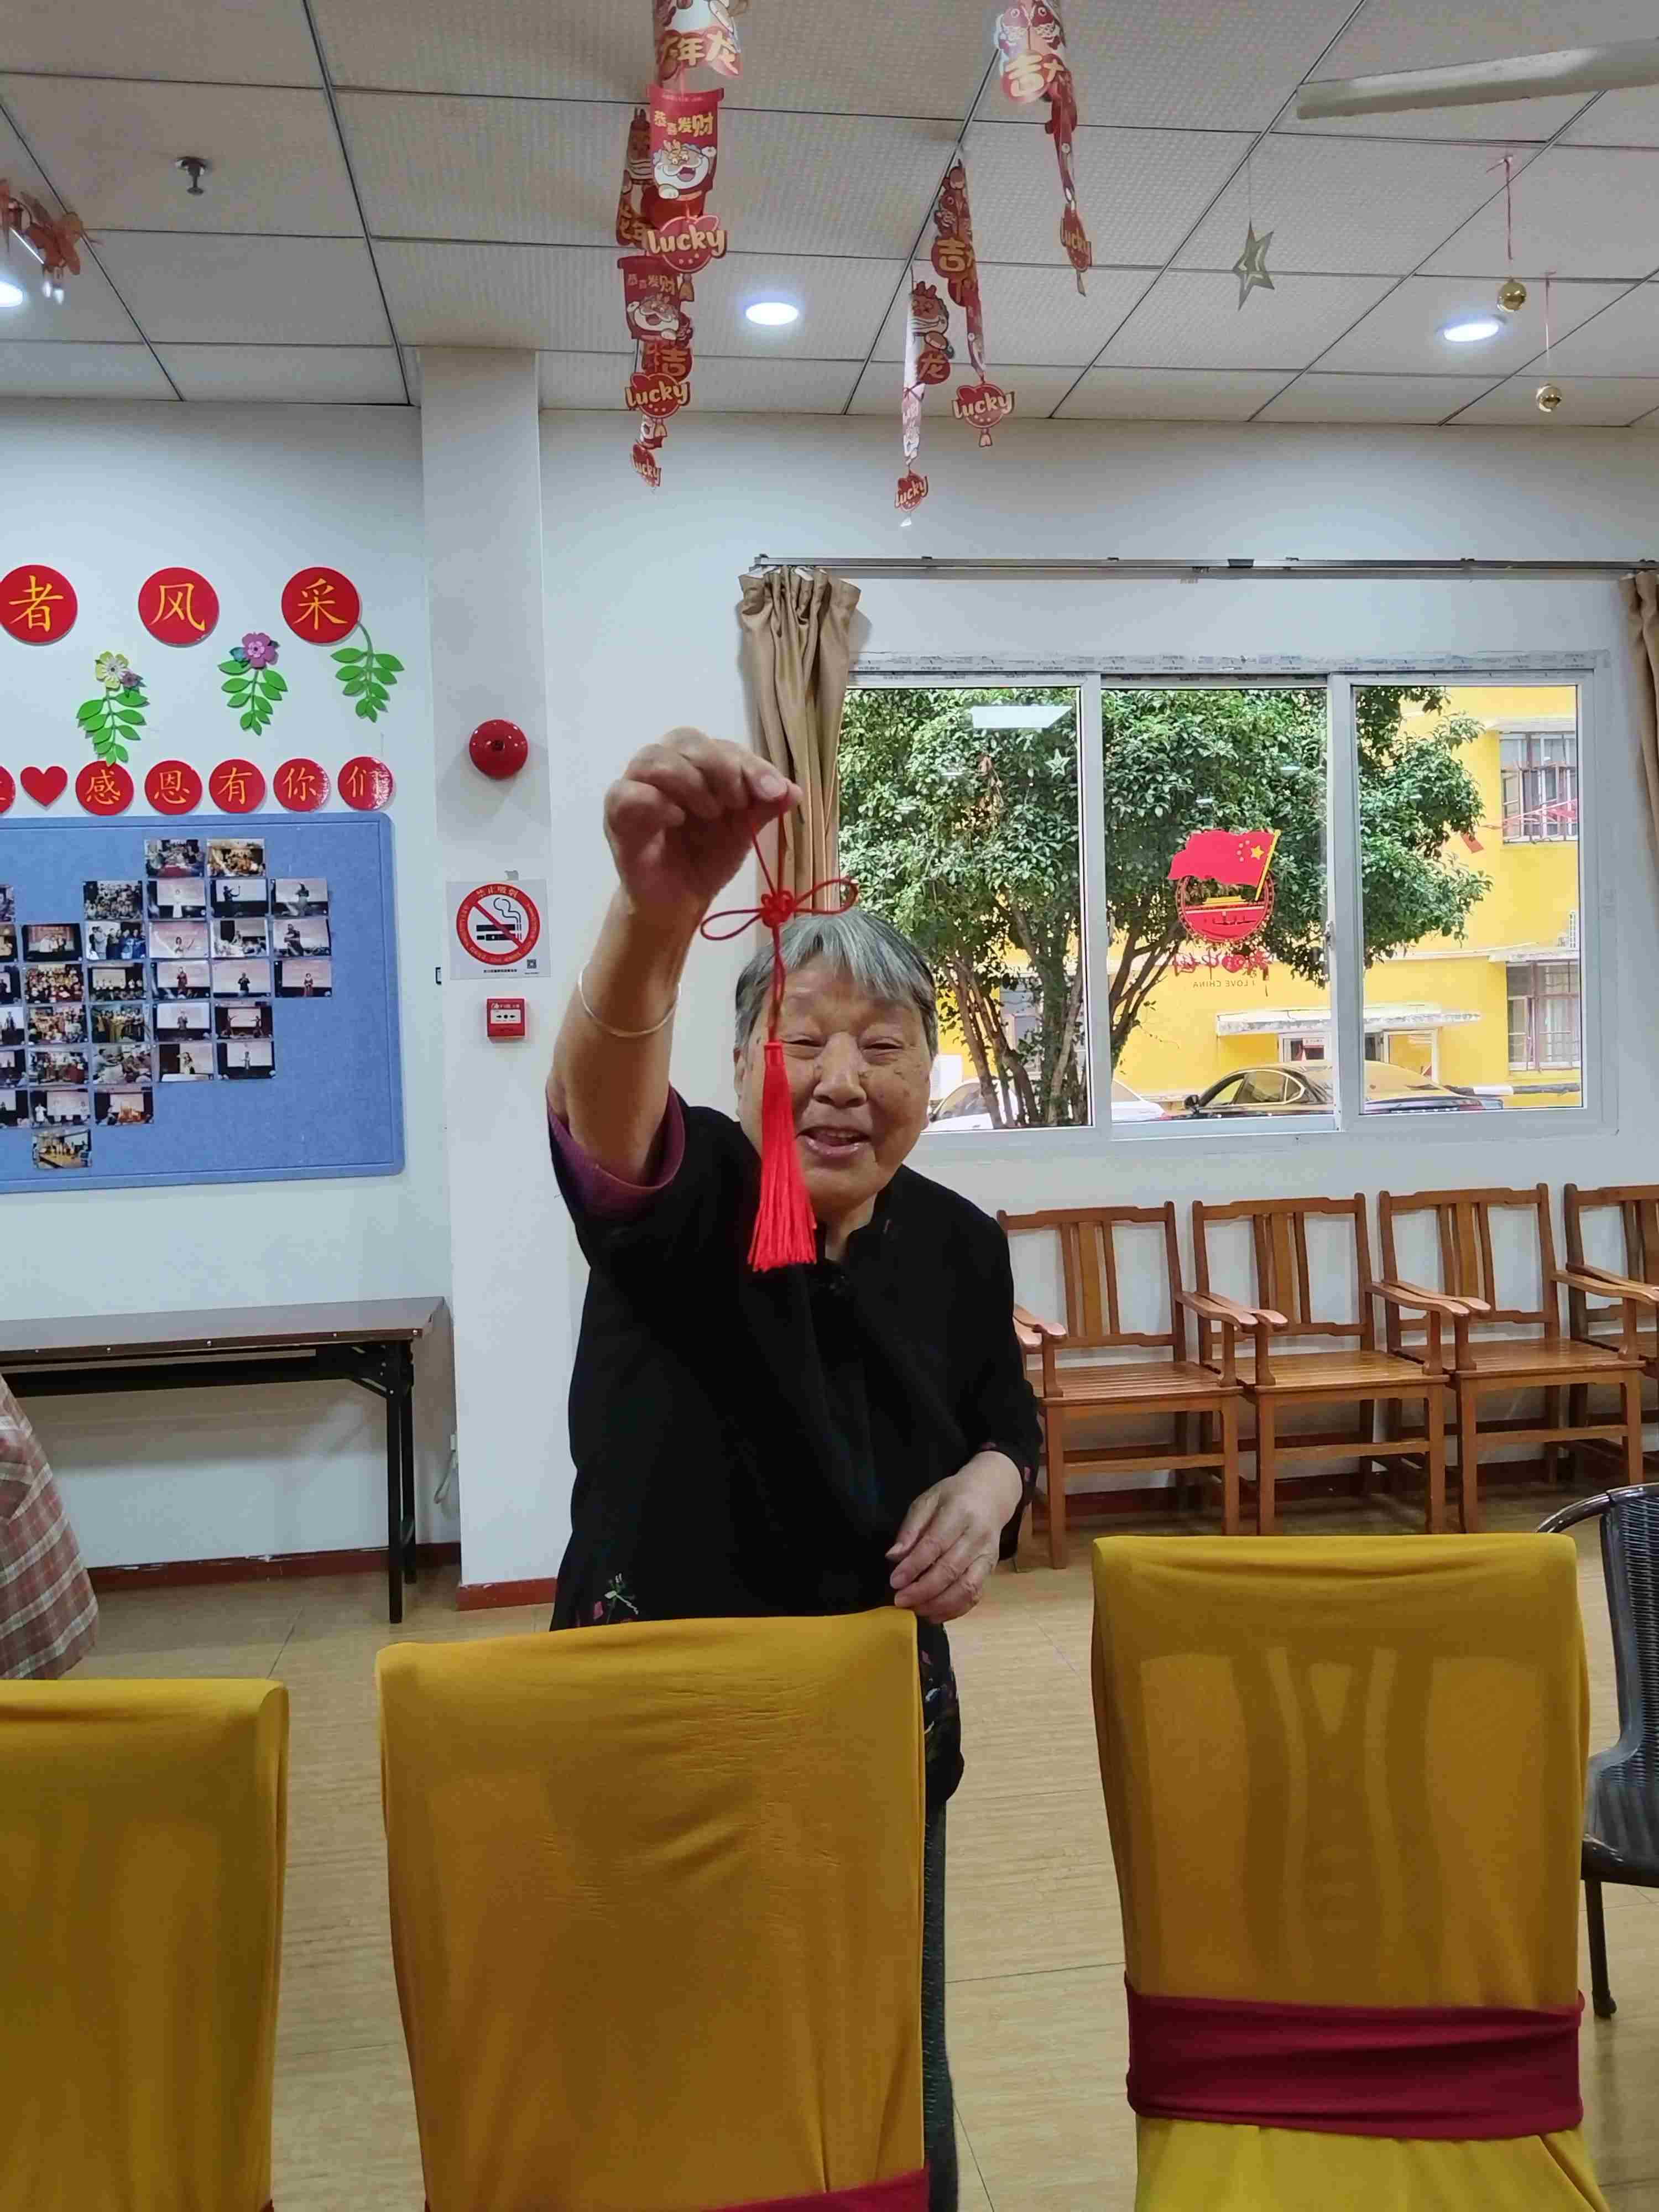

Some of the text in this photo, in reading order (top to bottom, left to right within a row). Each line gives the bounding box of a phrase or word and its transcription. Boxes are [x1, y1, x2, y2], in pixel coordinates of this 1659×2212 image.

[654, 111, 713, 137] 恭喜发财
[646, 223, 725, 256] lucky
[920, 353, 945, 378] 龙
[627, 380, 689, 407] lucky
[952, 392, 1013, 419] lucky
[895, 477, 927, 507] lucky
[8, 575, 348, 633] 者风采
[85, 766, 378, 805] 感恩有你们
